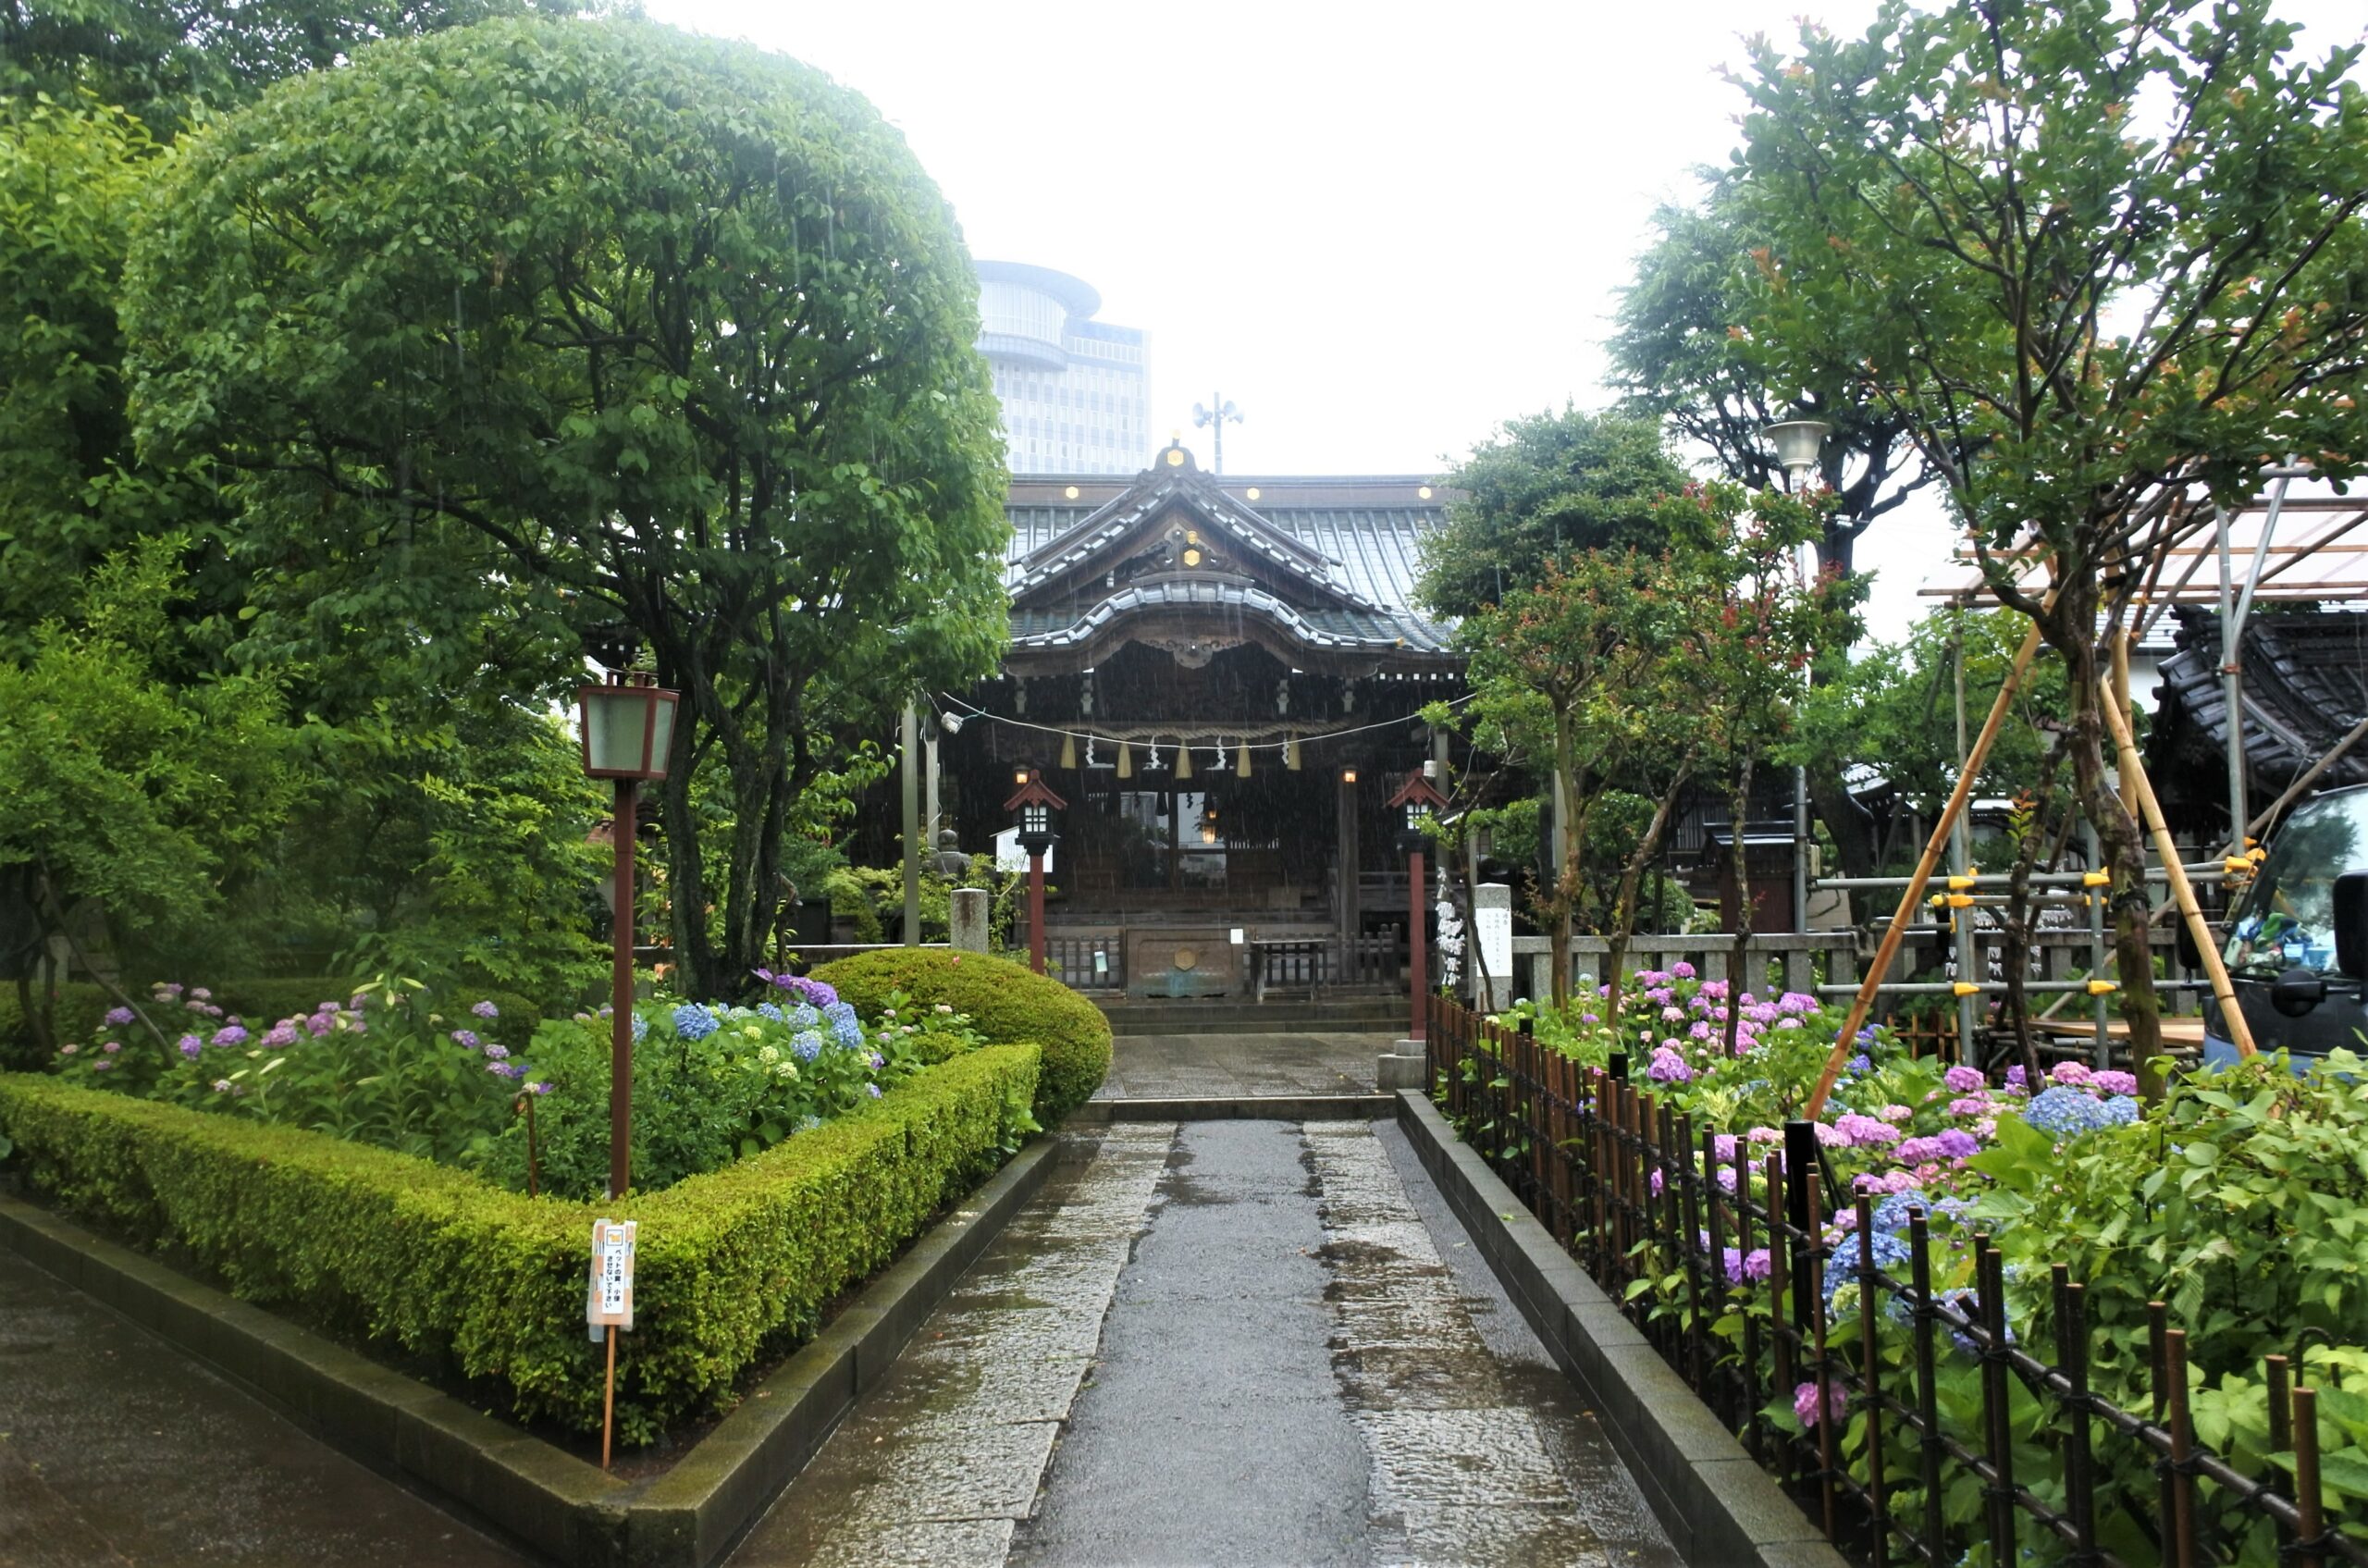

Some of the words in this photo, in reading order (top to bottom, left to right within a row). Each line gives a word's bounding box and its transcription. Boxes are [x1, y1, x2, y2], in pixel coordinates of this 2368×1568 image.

[605, 1255, 613, 1308] させないで下さい
